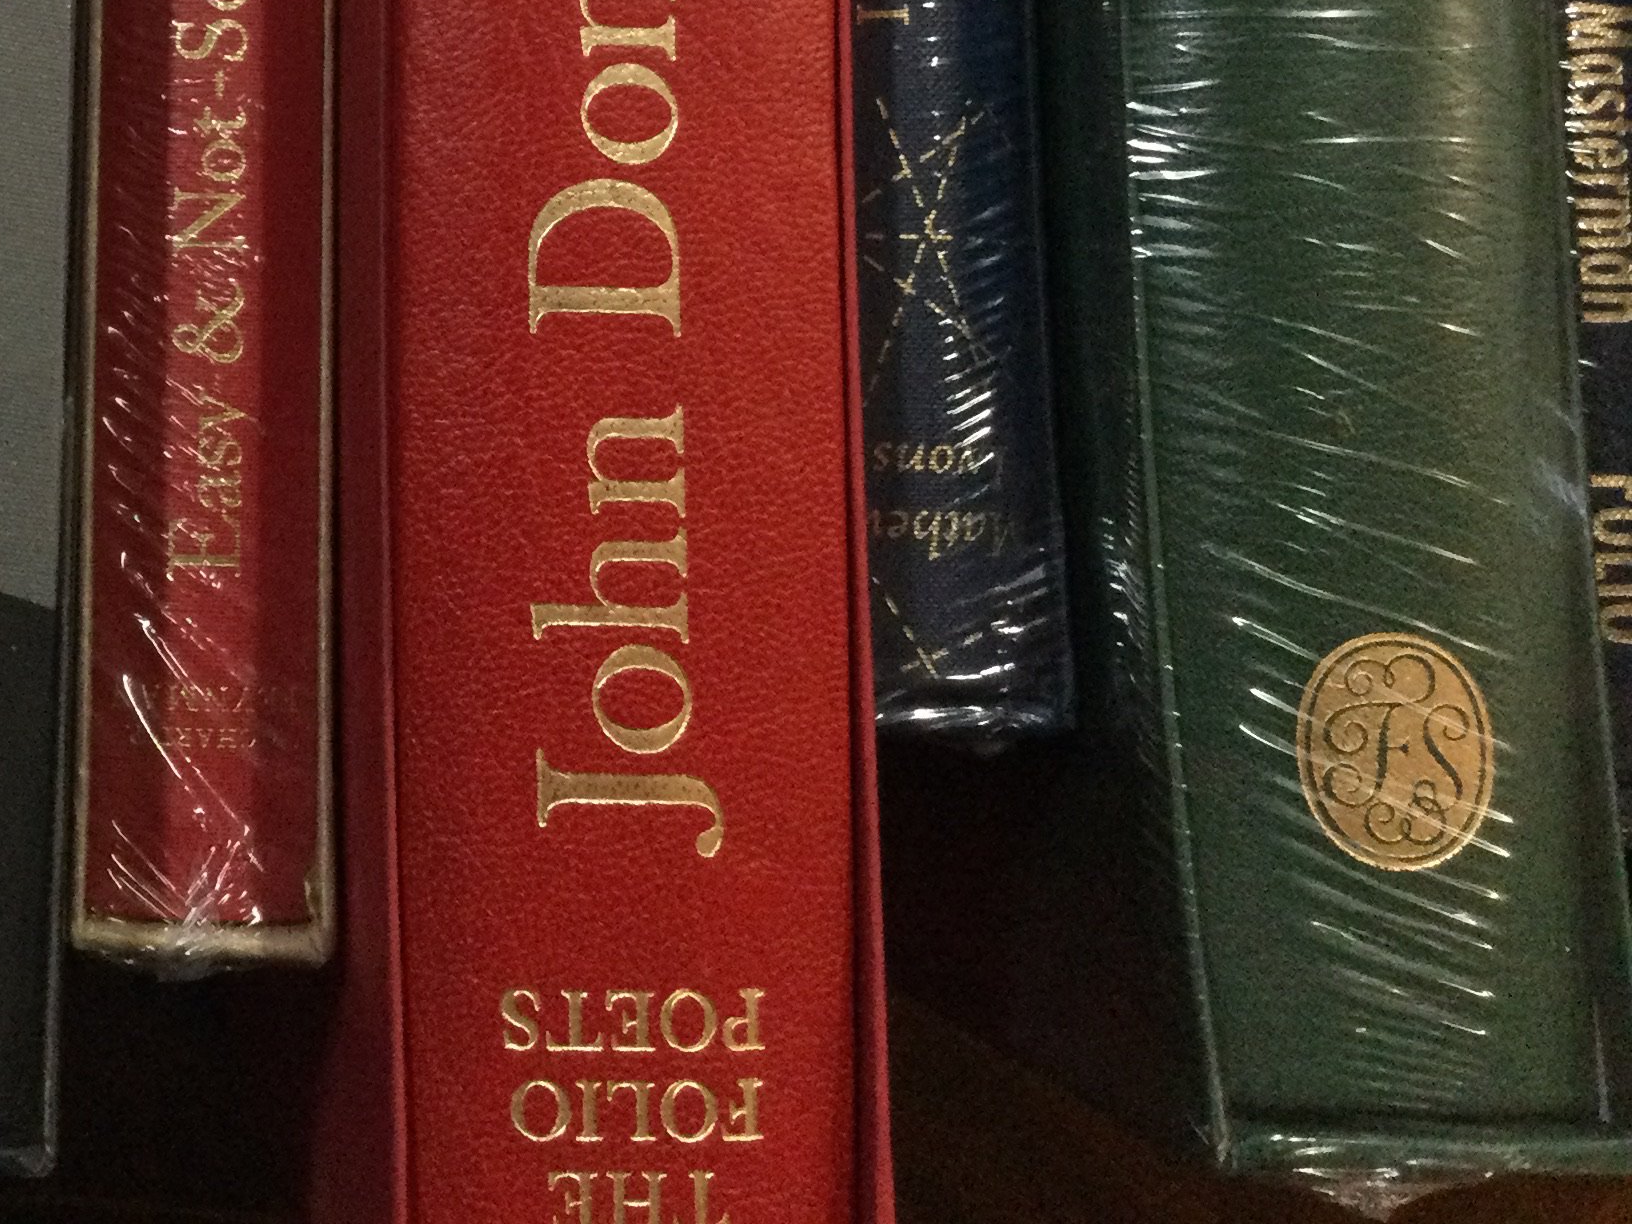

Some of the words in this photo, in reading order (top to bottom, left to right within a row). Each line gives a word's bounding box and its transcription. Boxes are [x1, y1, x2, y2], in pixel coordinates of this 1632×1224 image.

[172, 279, 245, 363] &
[168, 392, 251, 578] Easy
[530, 403, 724, 858] John
[499, 987, 766, 1053] POETS
[510, 1077, 764, 1143] FOLIO
[547, 1169, 731, 1224] THE
